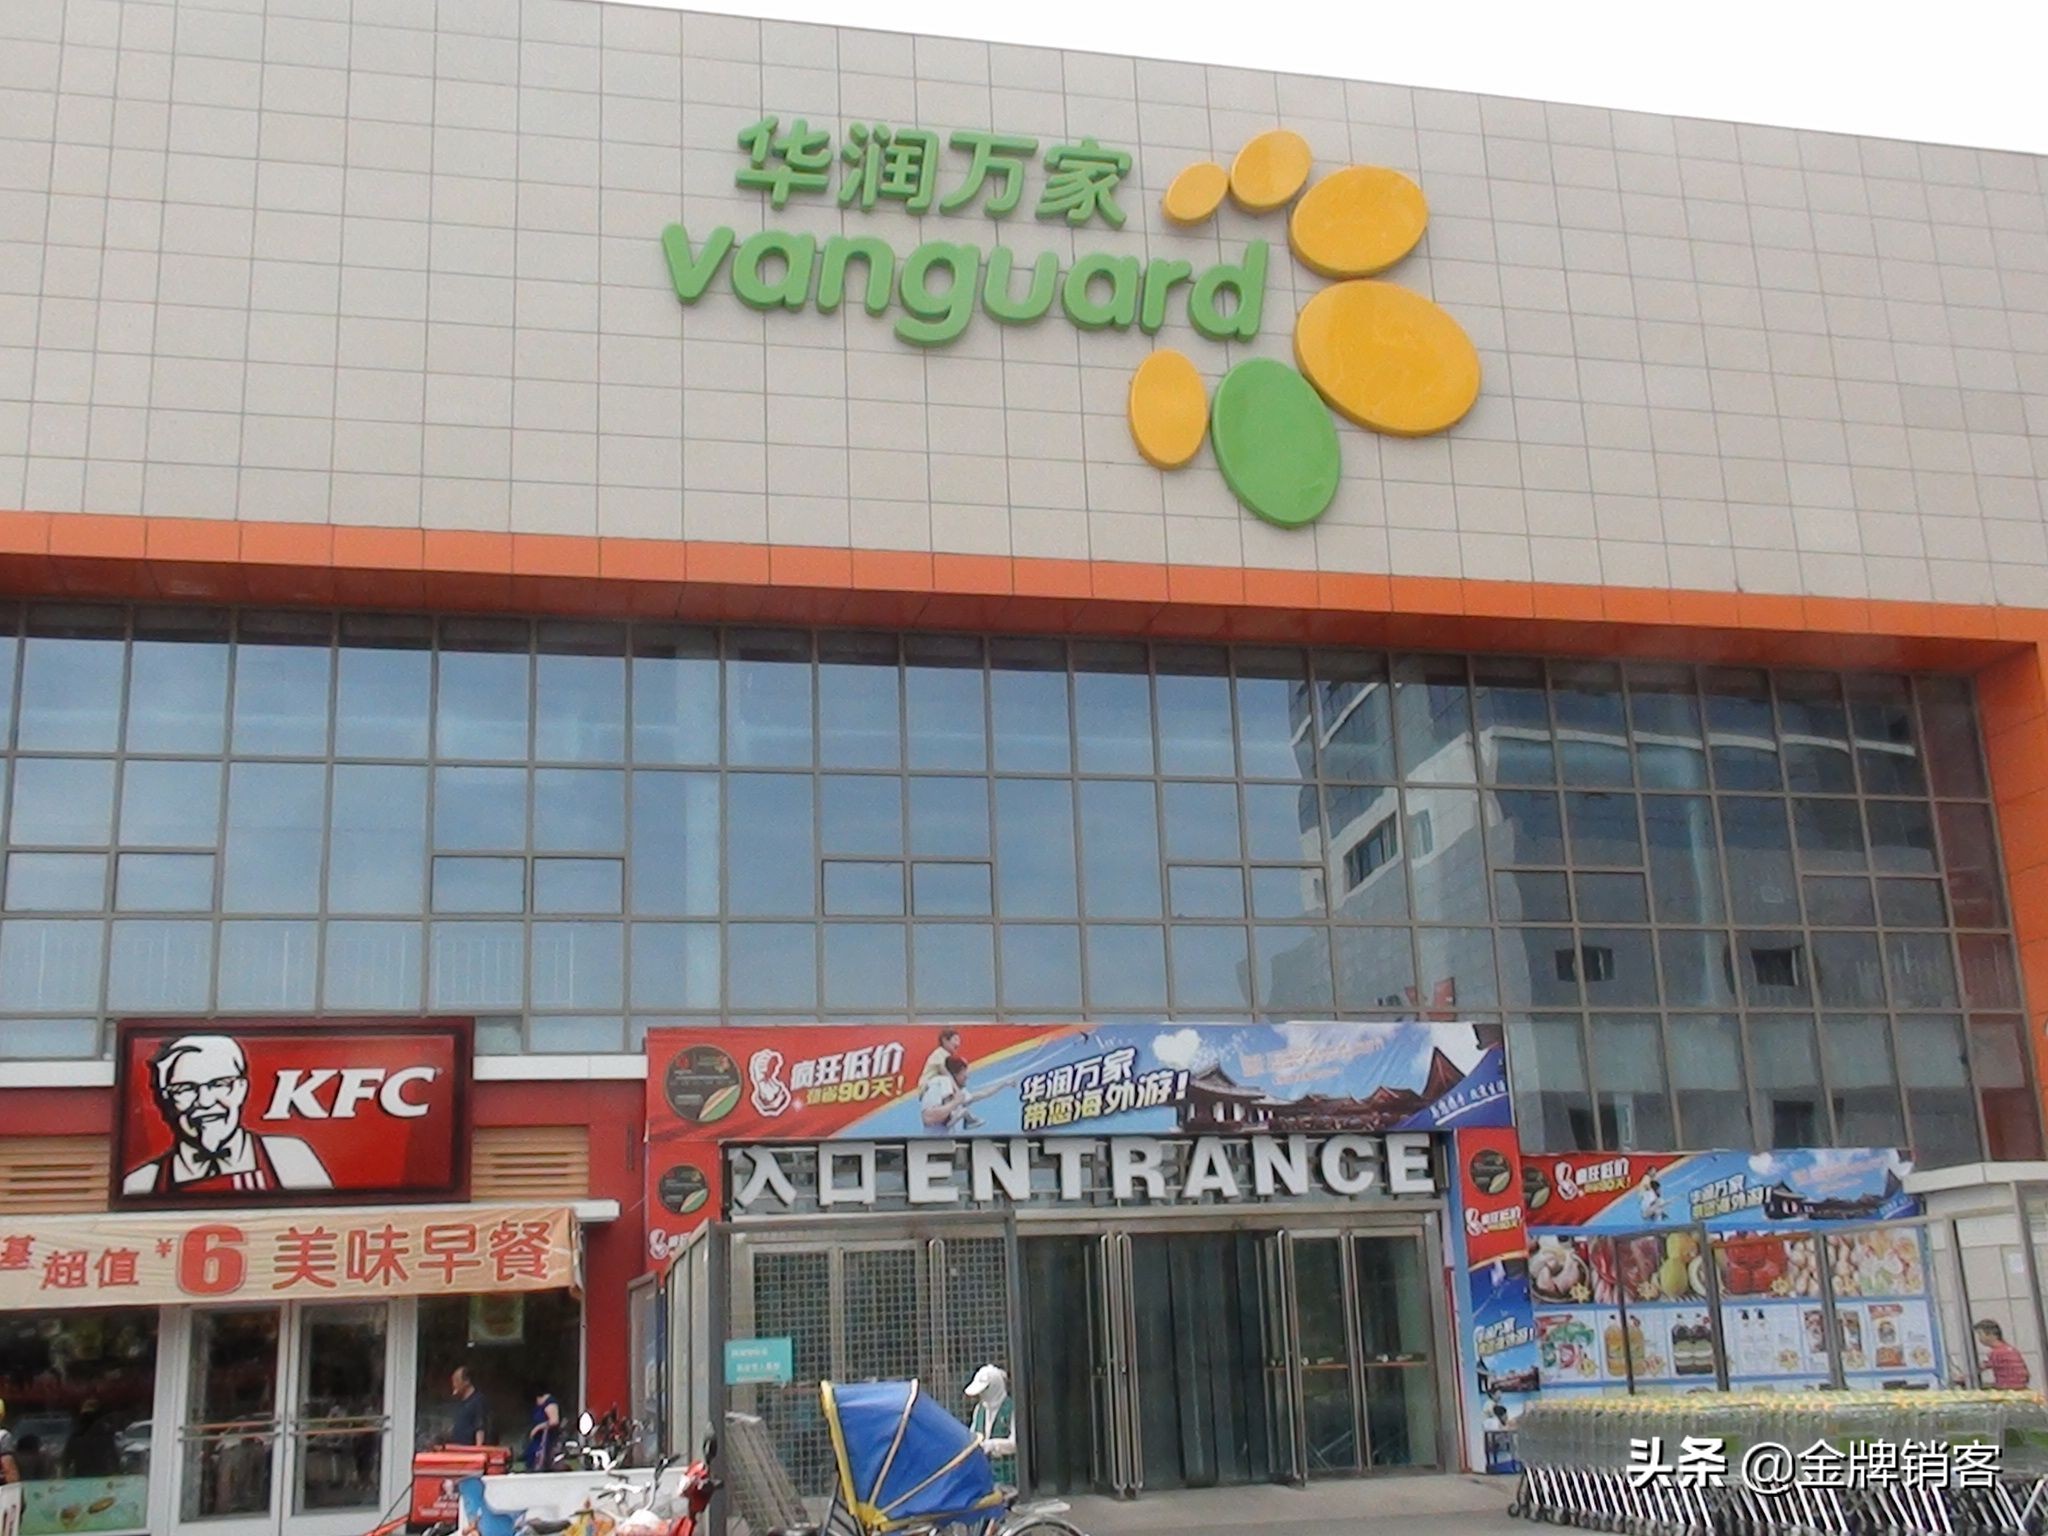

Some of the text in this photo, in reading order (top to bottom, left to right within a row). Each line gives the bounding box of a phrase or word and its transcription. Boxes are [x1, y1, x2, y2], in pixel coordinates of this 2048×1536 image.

[734, 115, 1133, 230] 华润万家
[661, 221, 1269, 347] vanguard
[263, 1066, 436, 1120] KFC
[1022, 1048, 1136, 1102] 华润万家
[1022, 1070, 1189, 1131] 带您海外游!
[735, 1141, 876, 1210] 入口
[908, 1134, 1435, 1204] ENTRANCE
[40, 1248, 140, 1290] 超值
[272, 1219, 550, 1291] 美味早餐
